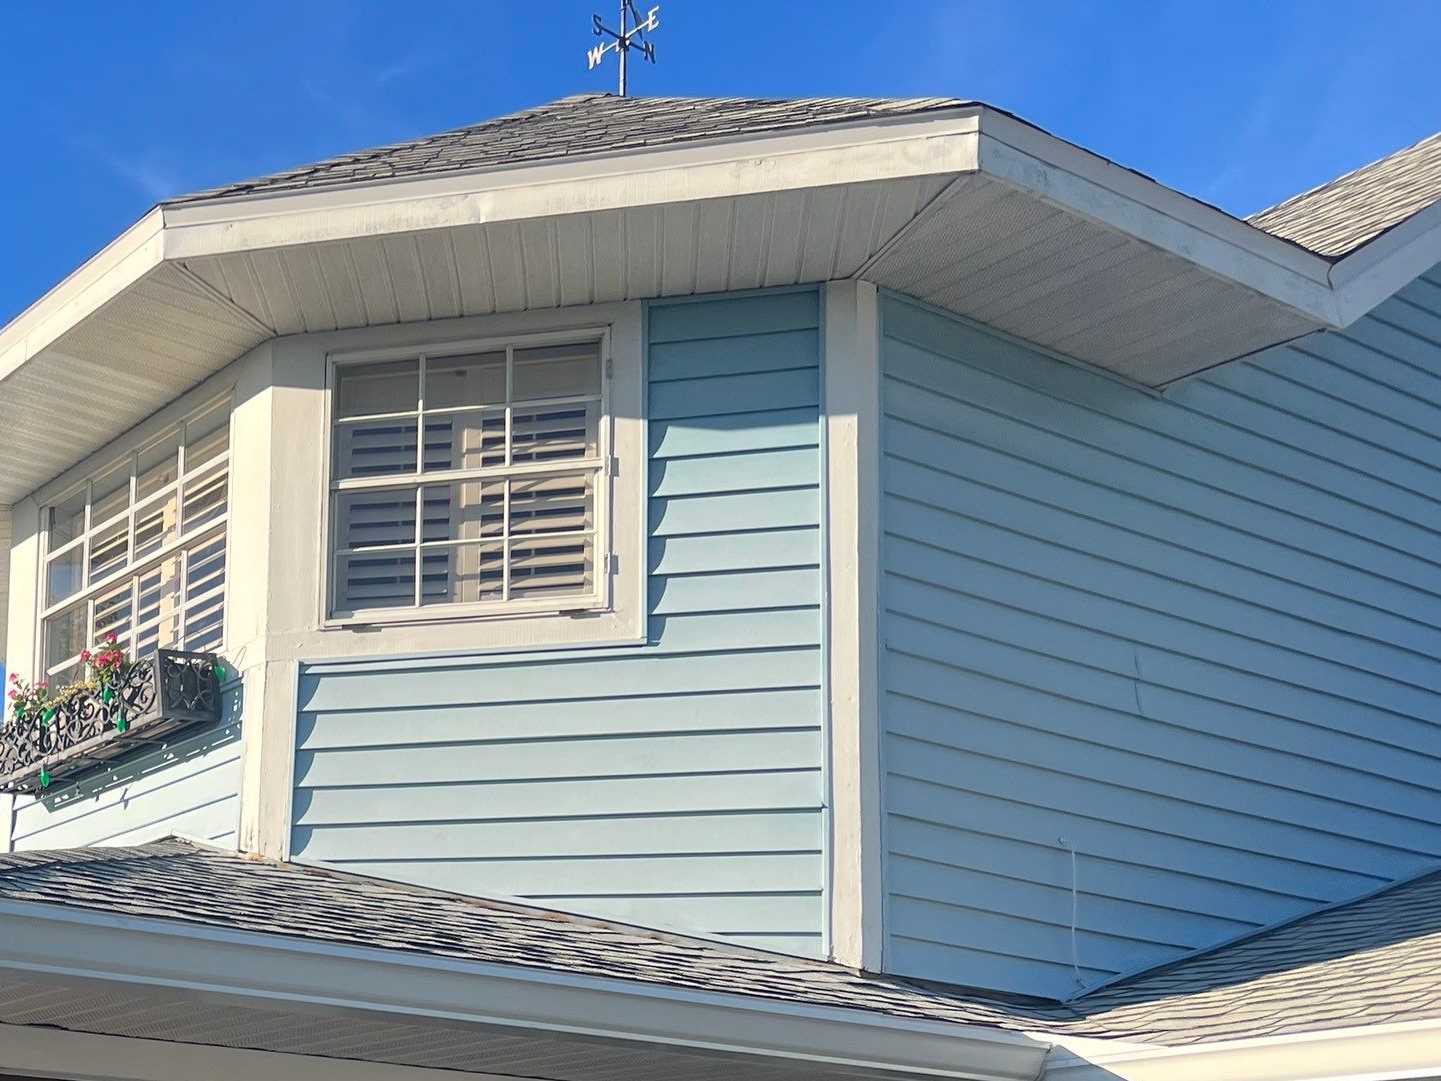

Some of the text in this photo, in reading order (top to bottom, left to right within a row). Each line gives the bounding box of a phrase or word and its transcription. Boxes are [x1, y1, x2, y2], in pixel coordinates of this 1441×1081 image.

[647, 5, 660, 32] E
[587, 42, 605, 70] W
[643, 40, 656, 64] N
